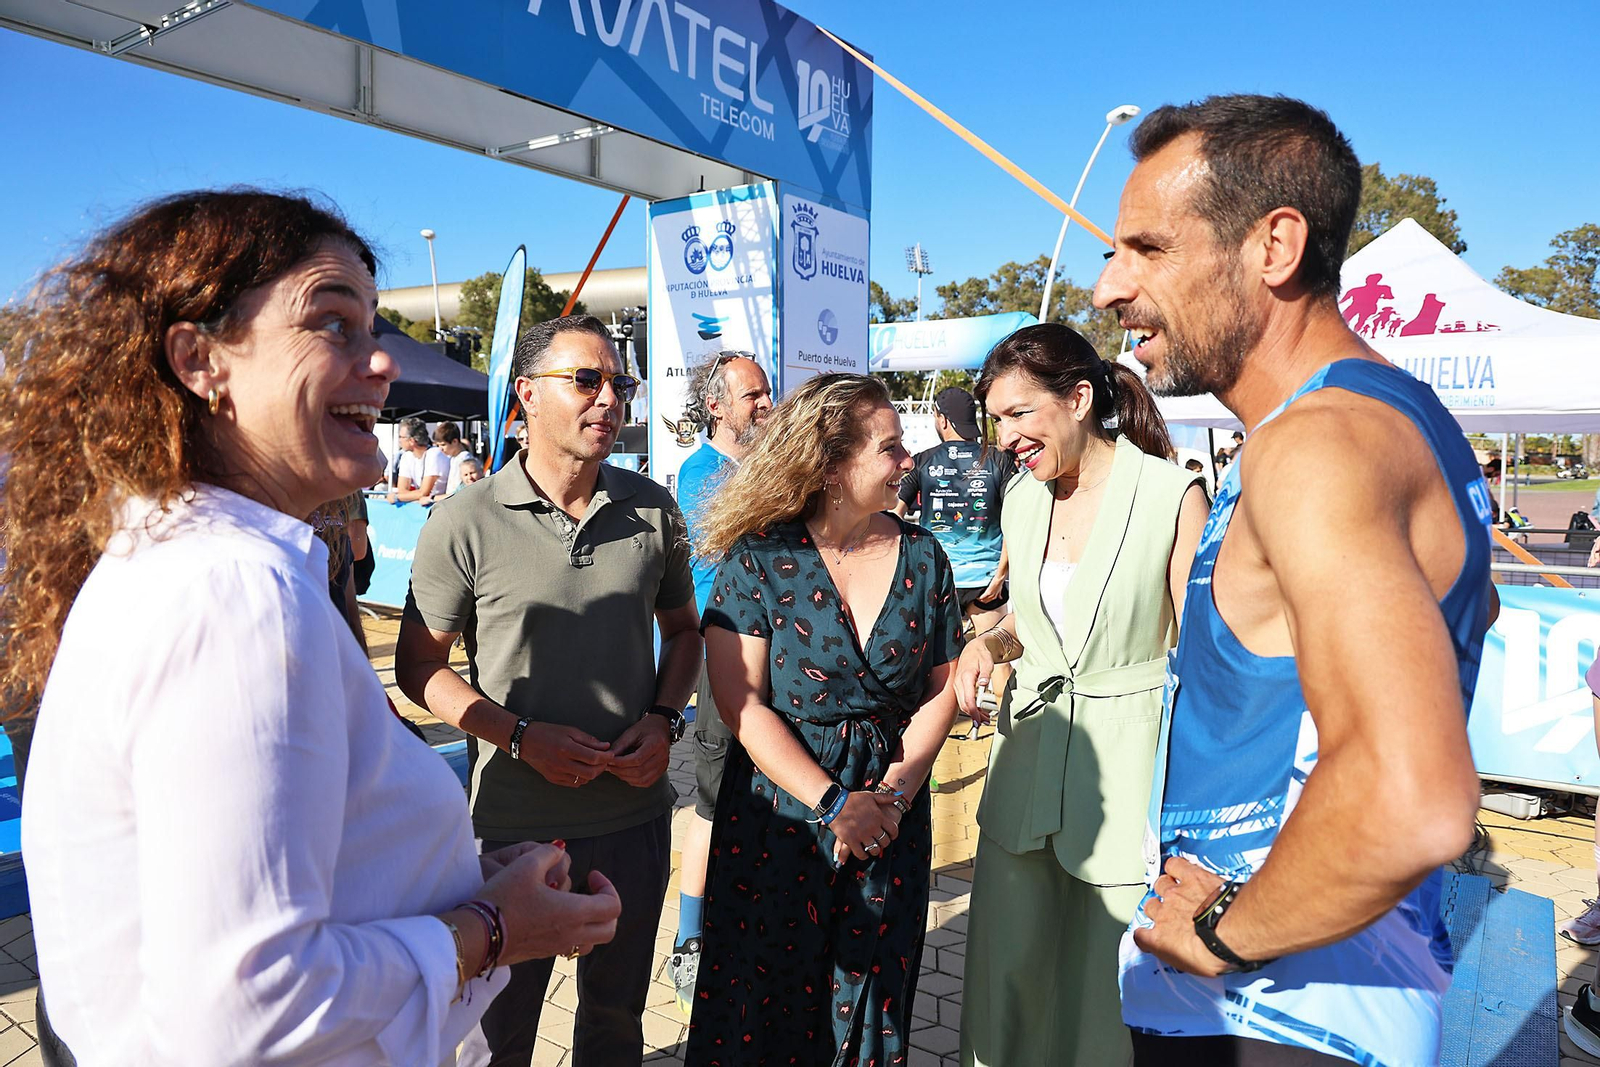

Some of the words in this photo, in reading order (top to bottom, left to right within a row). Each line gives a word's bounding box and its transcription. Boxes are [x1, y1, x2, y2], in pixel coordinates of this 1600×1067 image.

[700, 93, 776, 142] TELECOM
[821, 259, 865, 285] HUELVA
[664, 279, 709, 293] IPUTACIÓN
[798, 350, 822, 364] Puerto
[823, 353, 833, 364] de
[833, 356, 857, 368] Huelva
